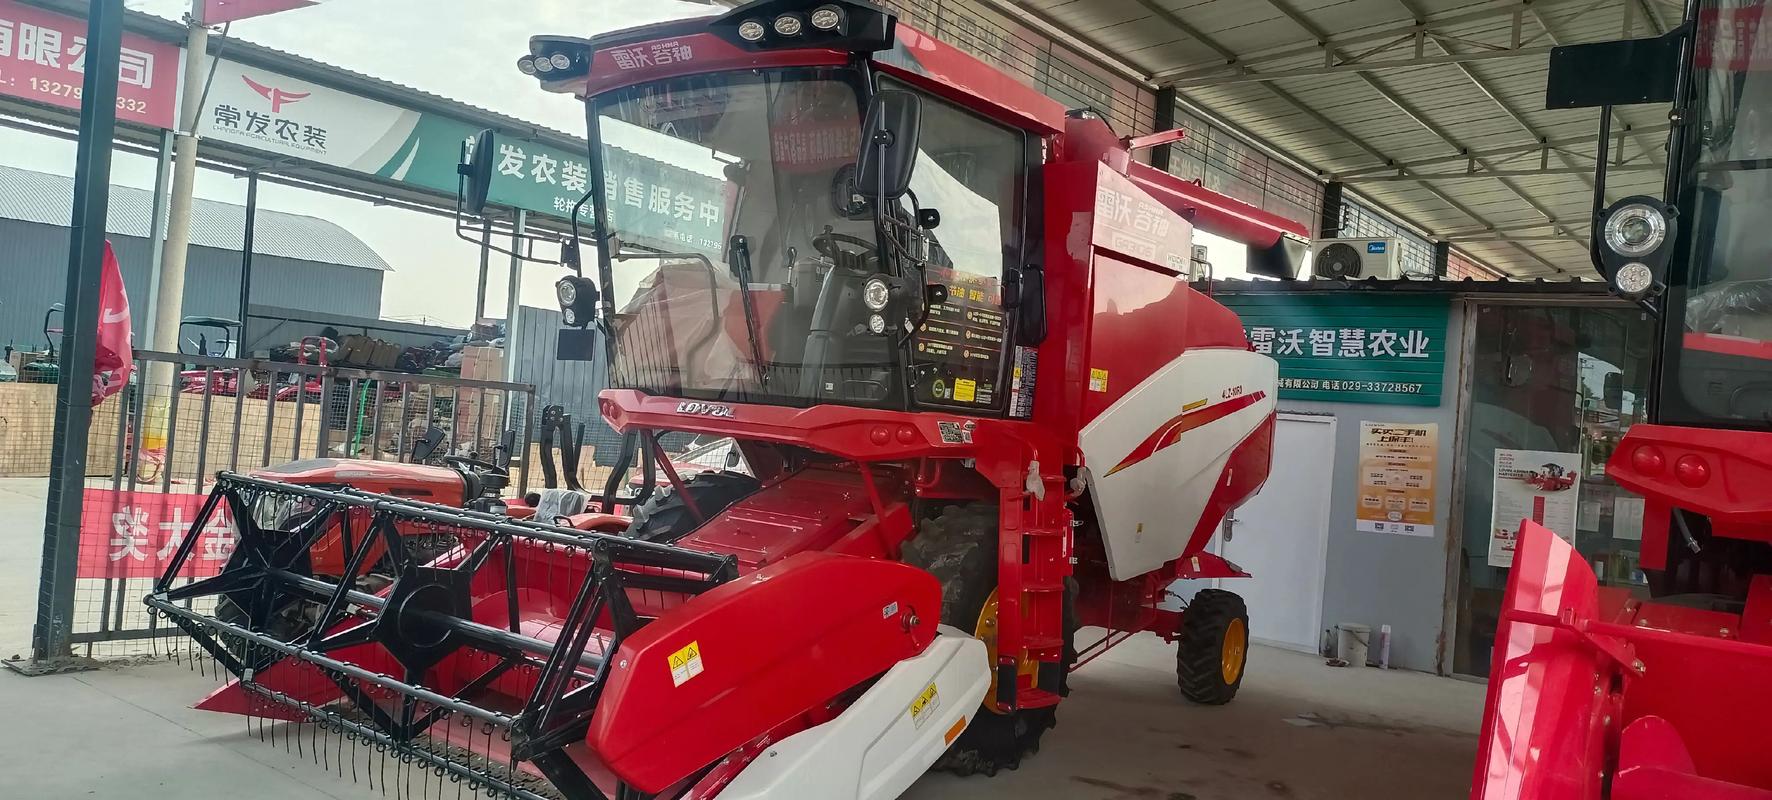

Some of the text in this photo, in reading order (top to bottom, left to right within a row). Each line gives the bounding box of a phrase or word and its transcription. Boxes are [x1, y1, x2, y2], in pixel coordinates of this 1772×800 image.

[610, 45, 693, 70] 雷沃谷神
[30, 77, 147, 114] 13279332
[214, 104, 327, 150] 常发农装
[1096, 186, 1170, 237] 雷沃谷神
[1243, 327, 1430, 358] 雷沃智慧农业
[1322, 380, 1340, 390] 电话
[1342, 381, 1423, 394] 029-33728567
